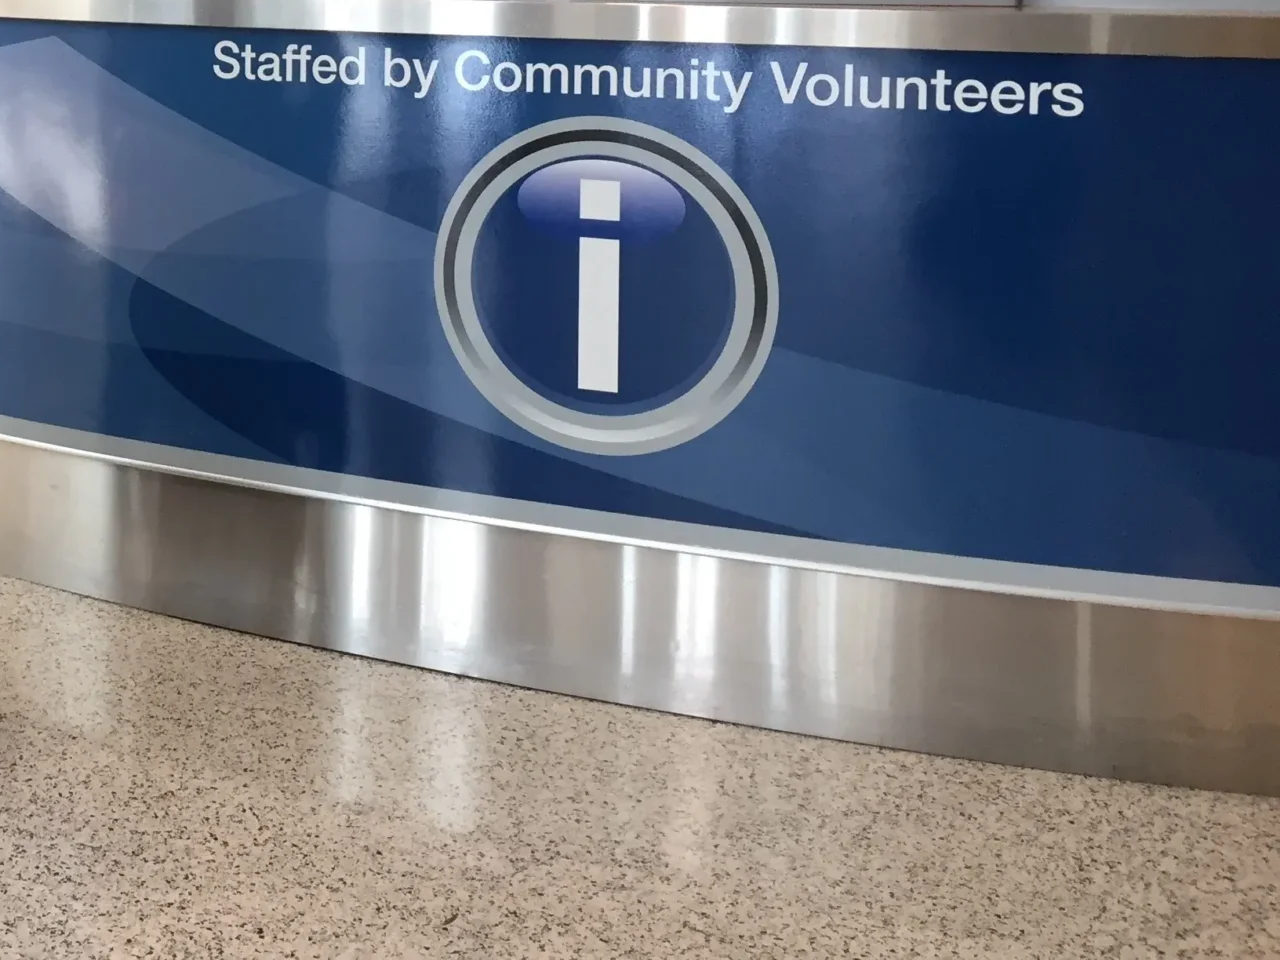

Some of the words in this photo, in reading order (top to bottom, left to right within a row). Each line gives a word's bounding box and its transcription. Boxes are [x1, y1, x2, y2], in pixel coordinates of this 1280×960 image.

[213, 40, 367, 85] Staffed
[383, 48, 439, 98] by
[455, 50, 753, 114] Community
[770, 61, 1085, 117] Volunteers
